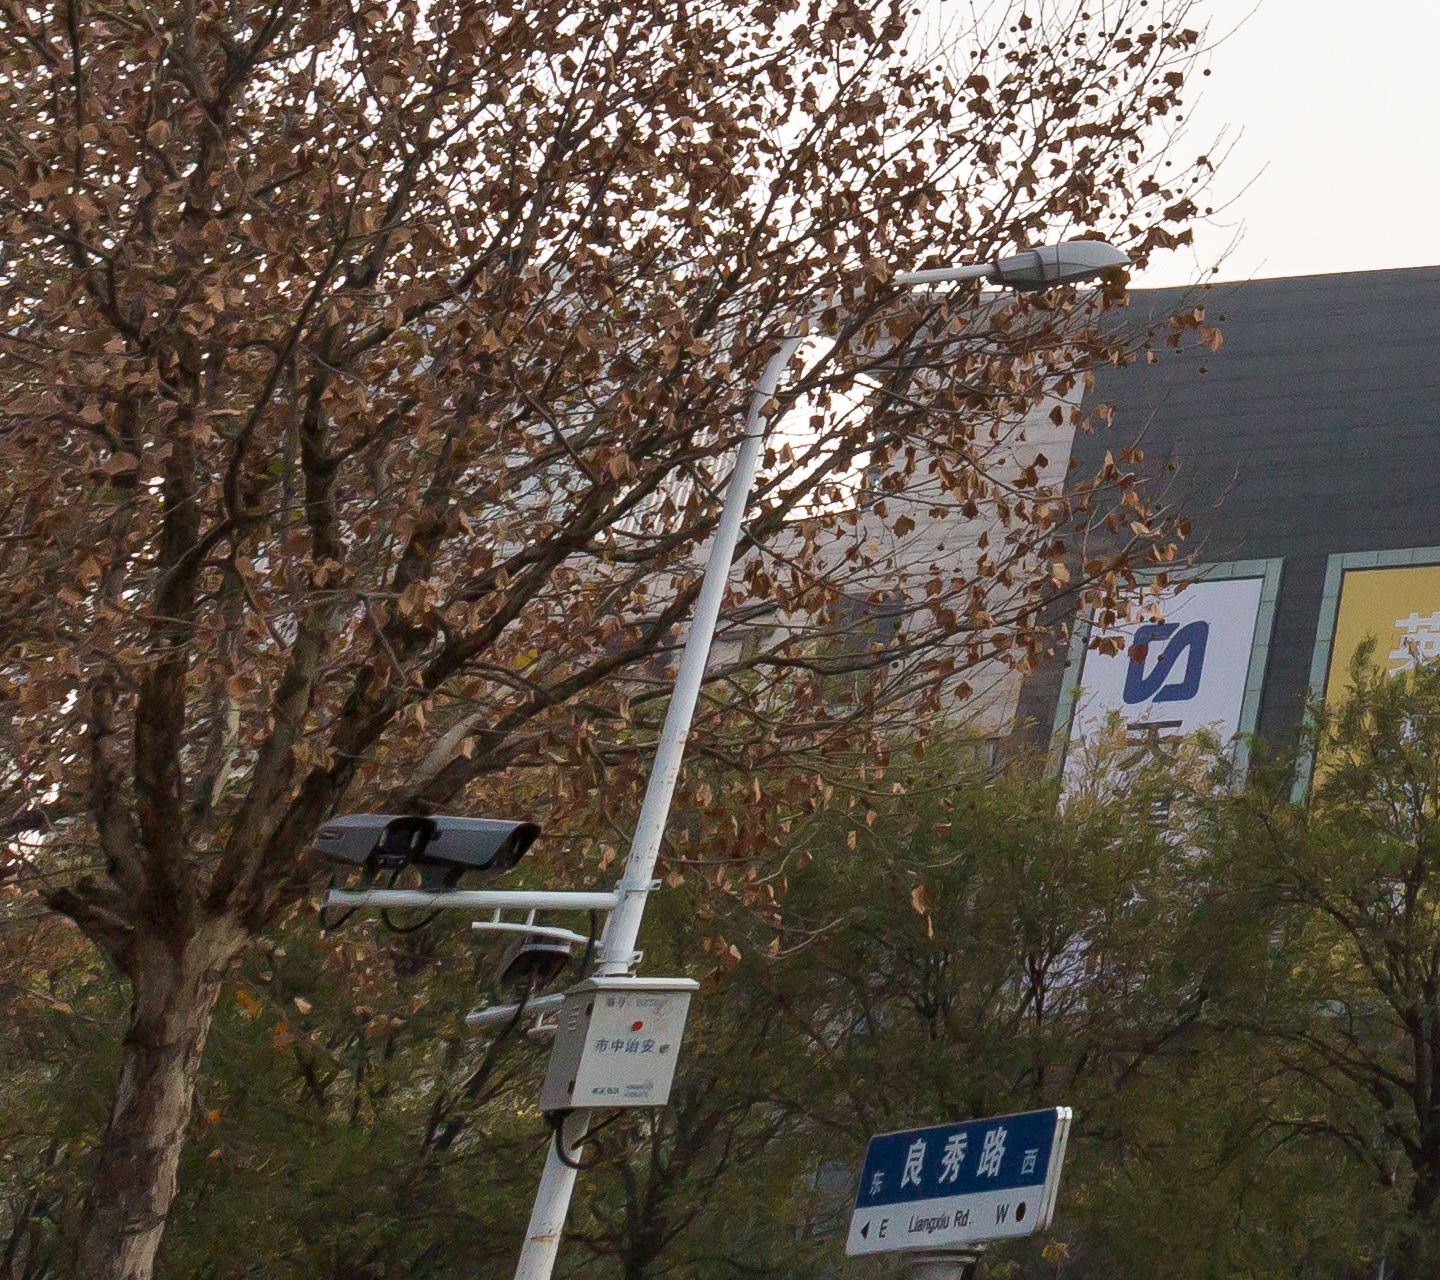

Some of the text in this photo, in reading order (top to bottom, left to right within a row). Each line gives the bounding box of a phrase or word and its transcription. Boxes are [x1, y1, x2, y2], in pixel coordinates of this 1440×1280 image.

[868, 1126, 1038, 1196] 东 良秀路 西
[879, 1218, 889, 1239] E
[908, 1210, 949, 1235] Liangxiu
[996, 1203, 1010, 1225] W
